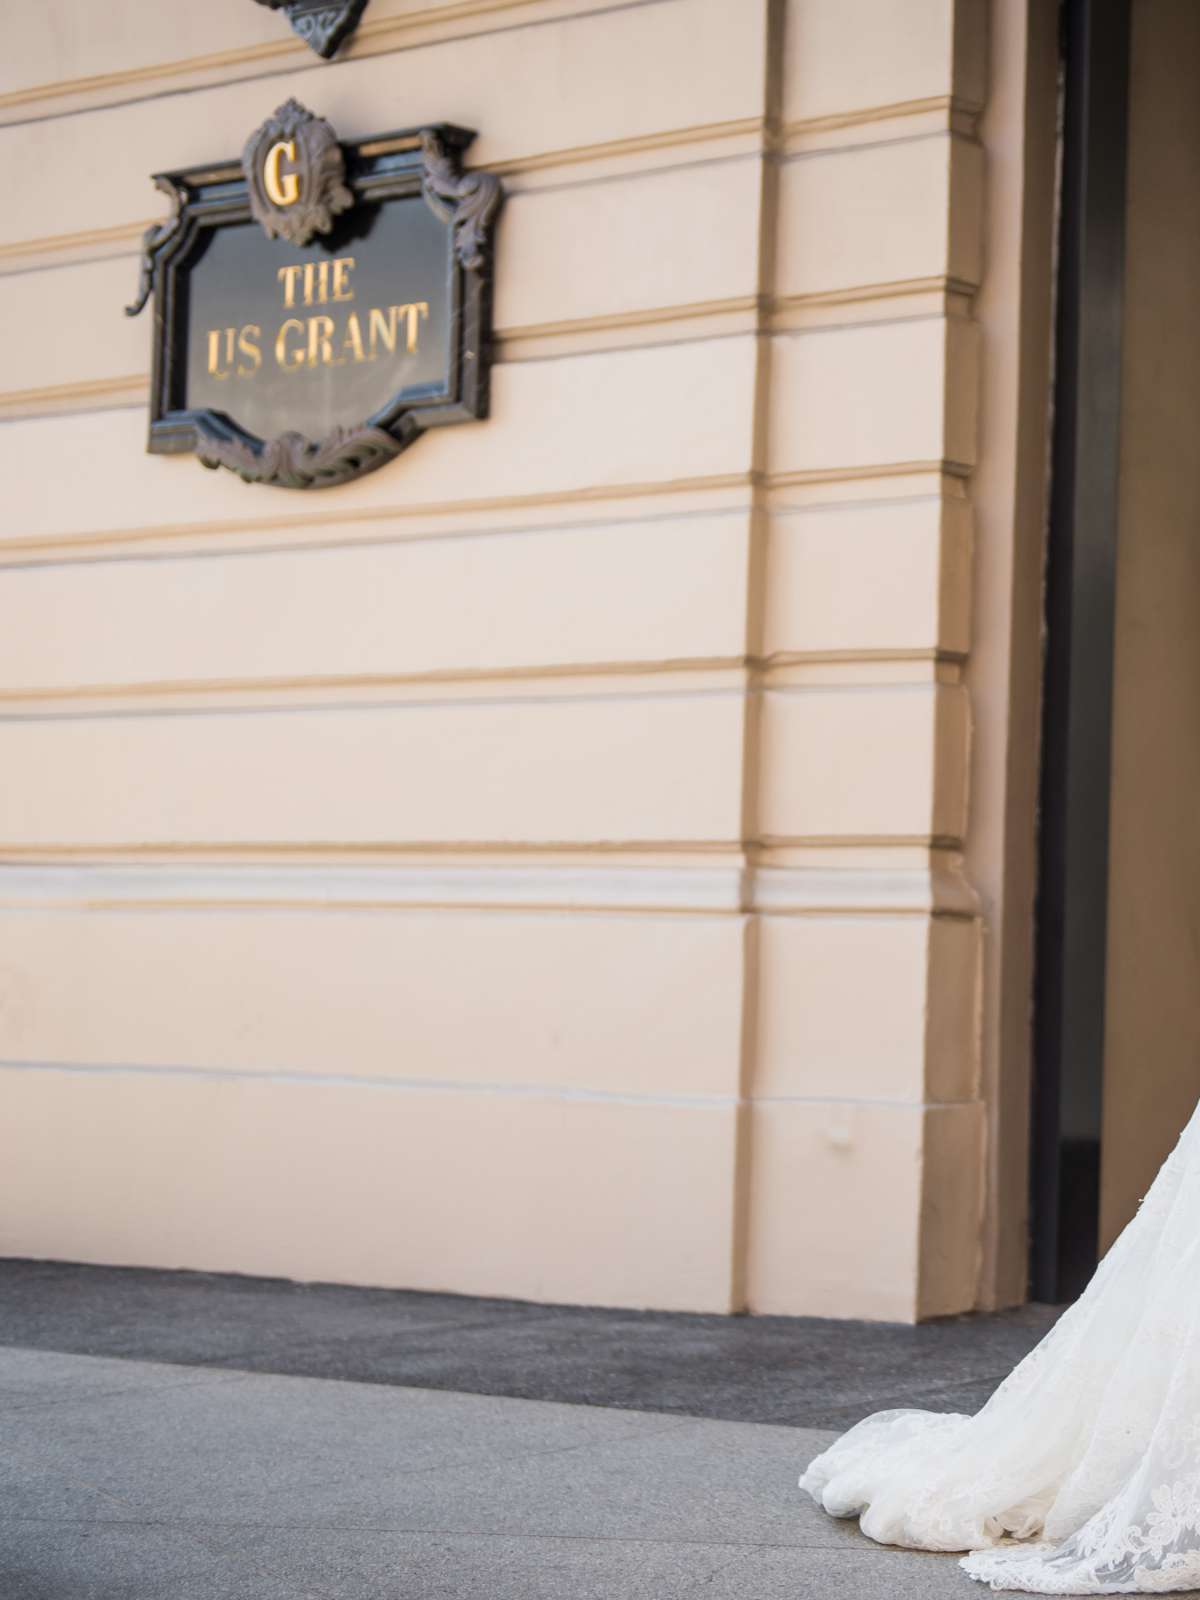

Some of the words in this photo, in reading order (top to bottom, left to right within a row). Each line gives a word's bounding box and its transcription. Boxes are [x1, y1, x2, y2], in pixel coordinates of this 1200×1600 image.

[264, 141, 299, 206] G
[277, 257, 355, 309] THE
[208, 324, 262, 380] US
[275, 302, 429, 371] GRANT
